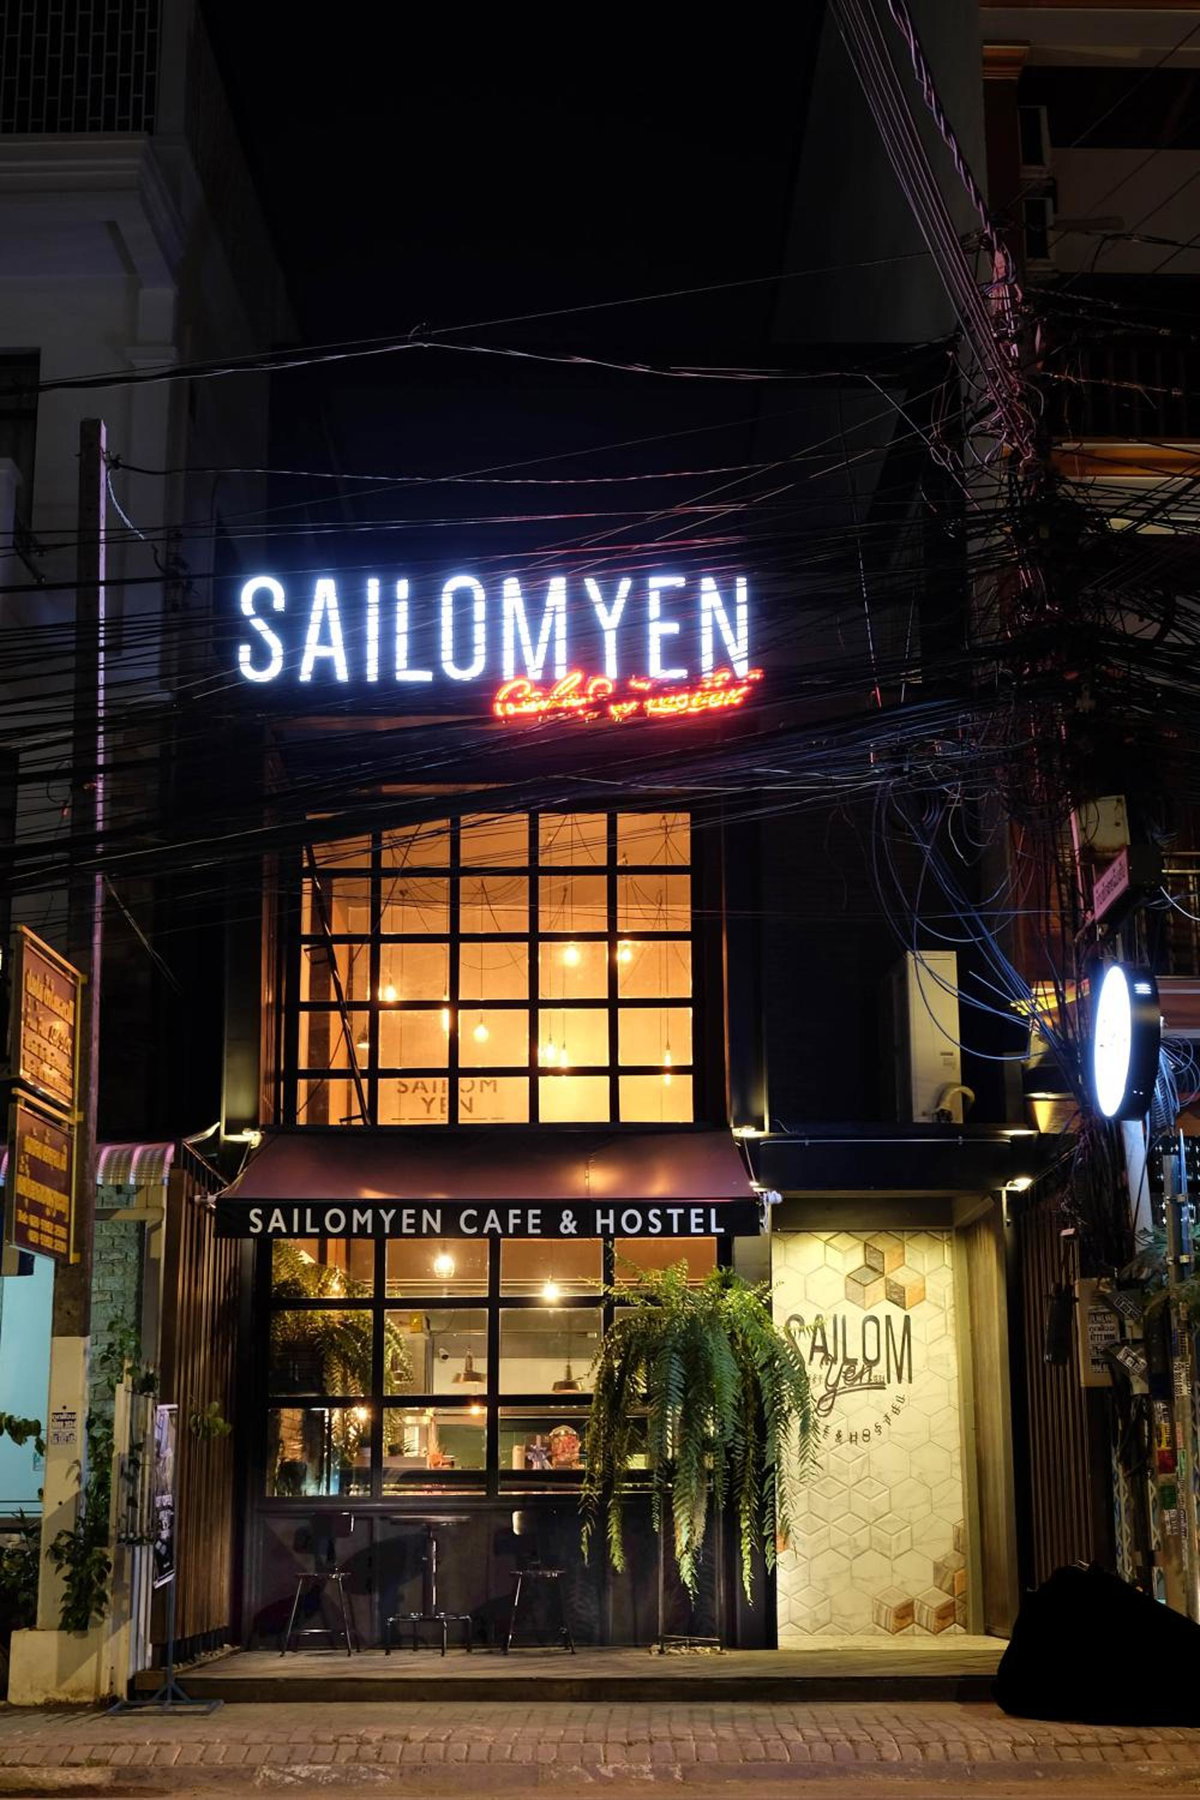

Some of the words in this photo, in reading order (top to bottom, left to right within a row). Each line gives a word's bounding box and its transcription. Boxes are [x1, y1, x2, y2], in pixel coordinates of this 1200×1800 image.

[238, 575, 750, 683] SAILOMYEN
[421, 1097, 474, 1114] YEN
[248, 1207, 442, 1234] SAILOMYEN
[459, 1208, 542, 1234] CAFE
[559, 1209, 578, 1234] &
[596, 1208, 725, 1234] HOSTEL
[783, 1313, 913, 1385] SAILOM
[849, 1393, 907, 1446] HOSTEL
